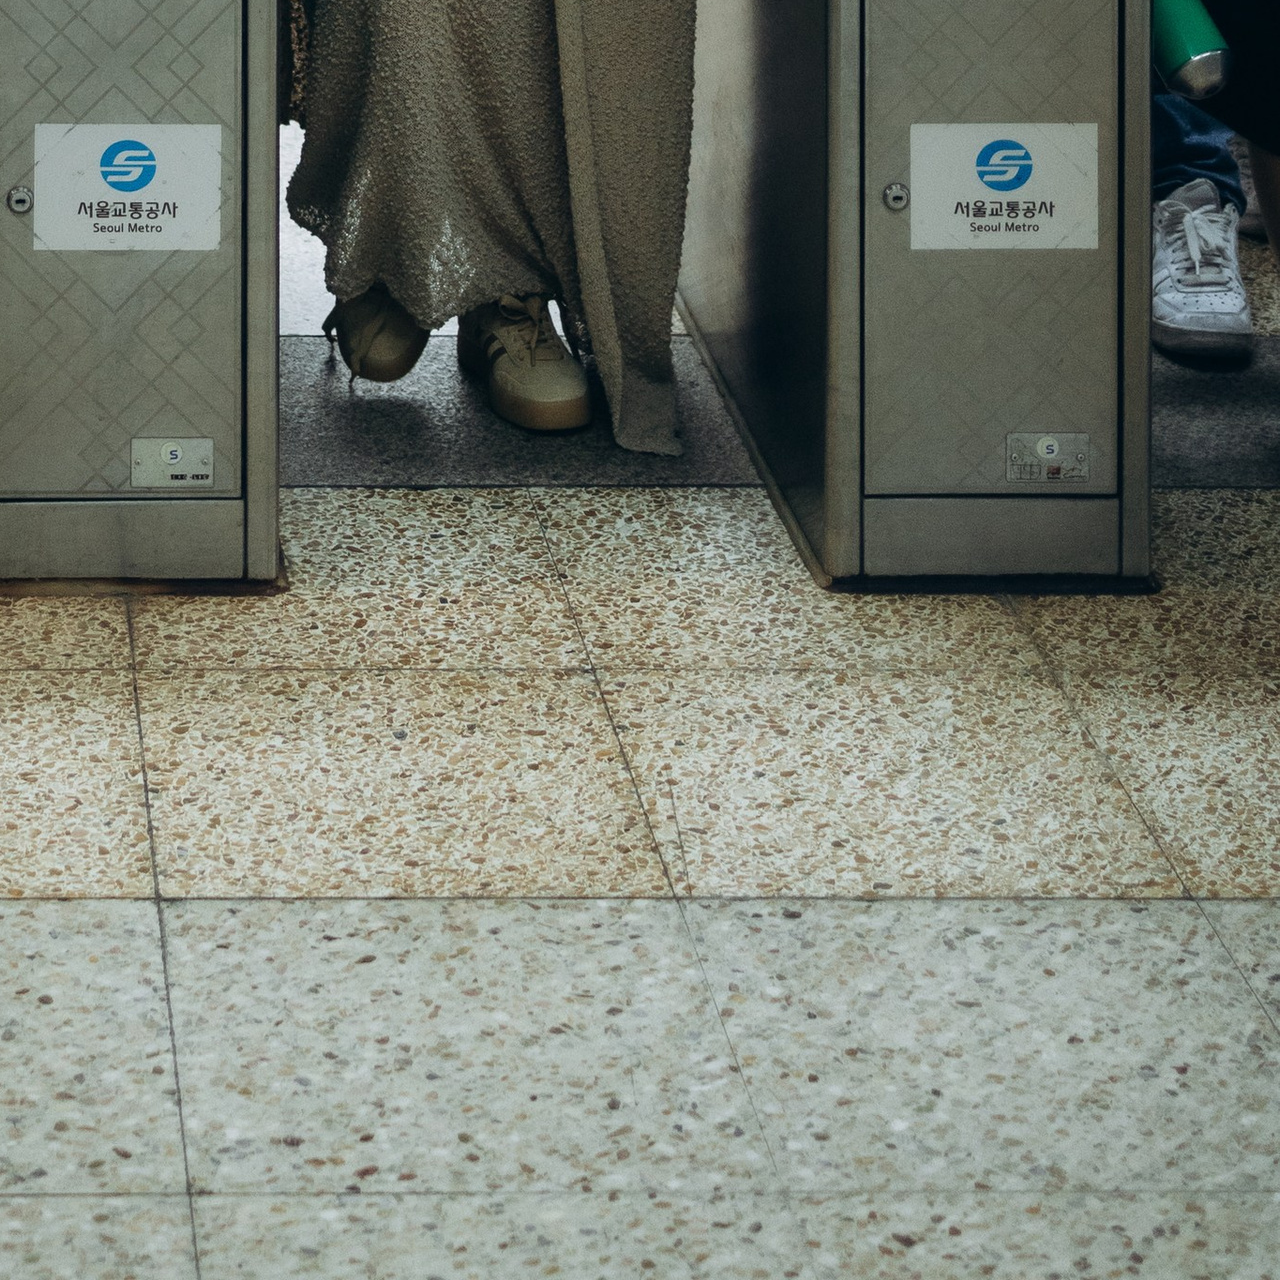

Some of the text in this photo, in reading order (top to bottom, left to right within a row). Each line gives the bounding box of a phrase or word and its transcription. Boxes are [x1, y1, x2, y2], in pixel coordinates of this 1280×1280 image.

[77, 201, 179, 220] 서울교통공사
[954, 200, 1056, 219] 서울교통공사
[93, 223, 163, 234] Seoul Metro
[970, 222, 1040, 233] Seoul Metro
